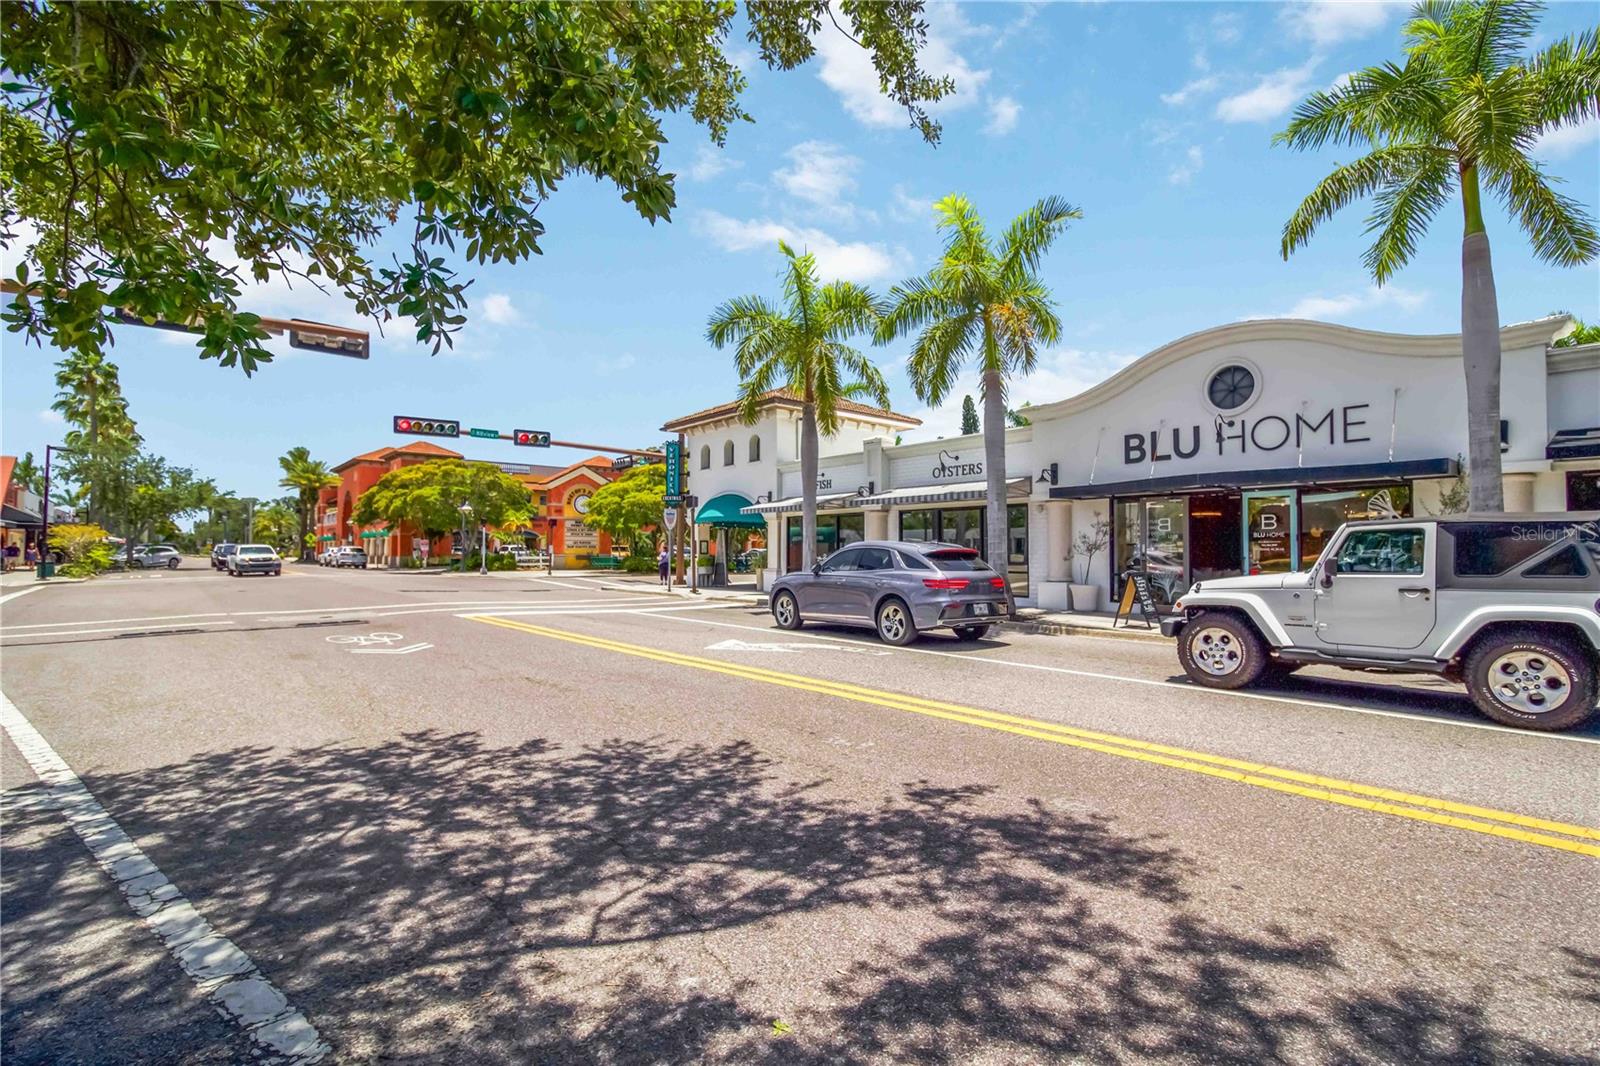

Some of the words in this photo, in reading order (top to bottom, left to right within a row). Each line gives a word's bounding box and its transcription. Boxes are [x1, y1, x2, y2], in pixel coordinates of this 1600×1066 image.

[1124, 425, 1200, 465] BLU
[1217, 404, 1371, 456] HOME
[932, 462, 983, 479] OYSTERS
[1261, 514, 1278, 530] B
